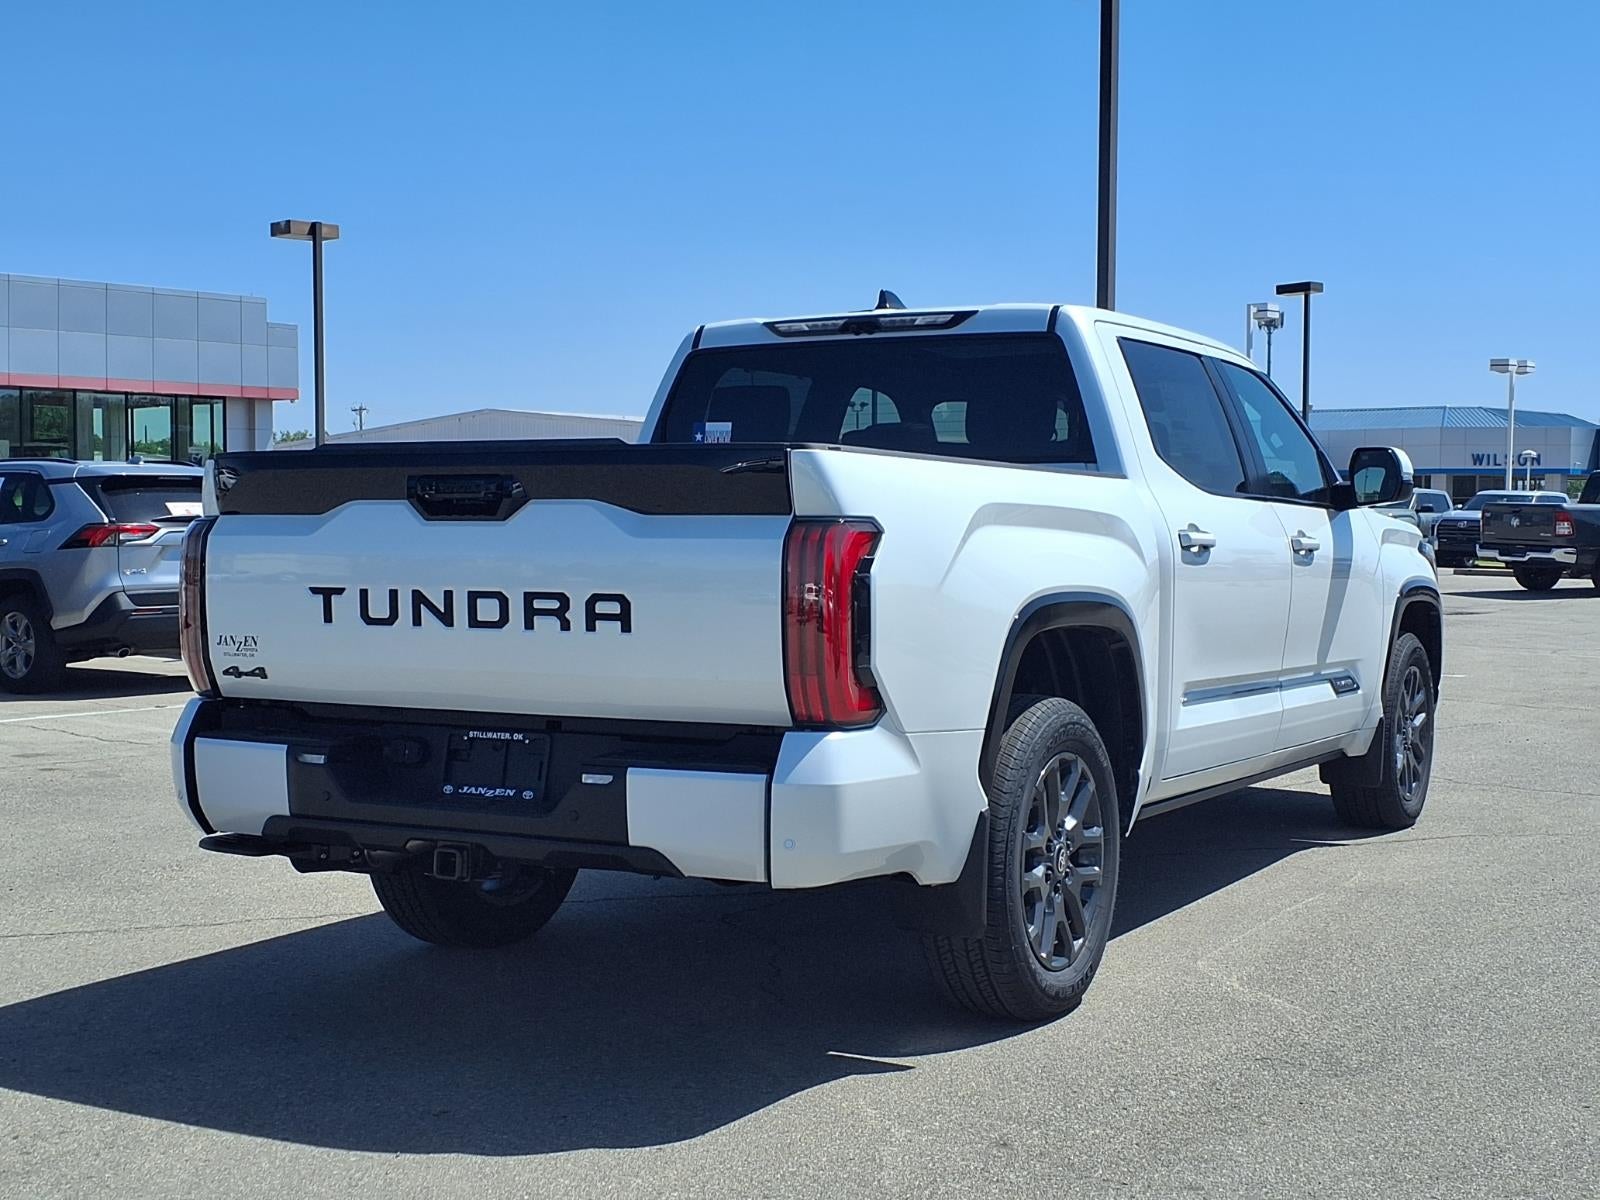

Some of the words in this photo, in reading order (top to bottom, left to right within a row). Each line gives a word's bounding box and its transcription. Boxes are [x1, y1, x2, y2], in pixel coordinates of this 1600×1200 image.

[308, 586, 632, 634] TUNDRA
[216, 635, 258, 652] JANZEN
[458, 786, 516, 796] JANZEN
